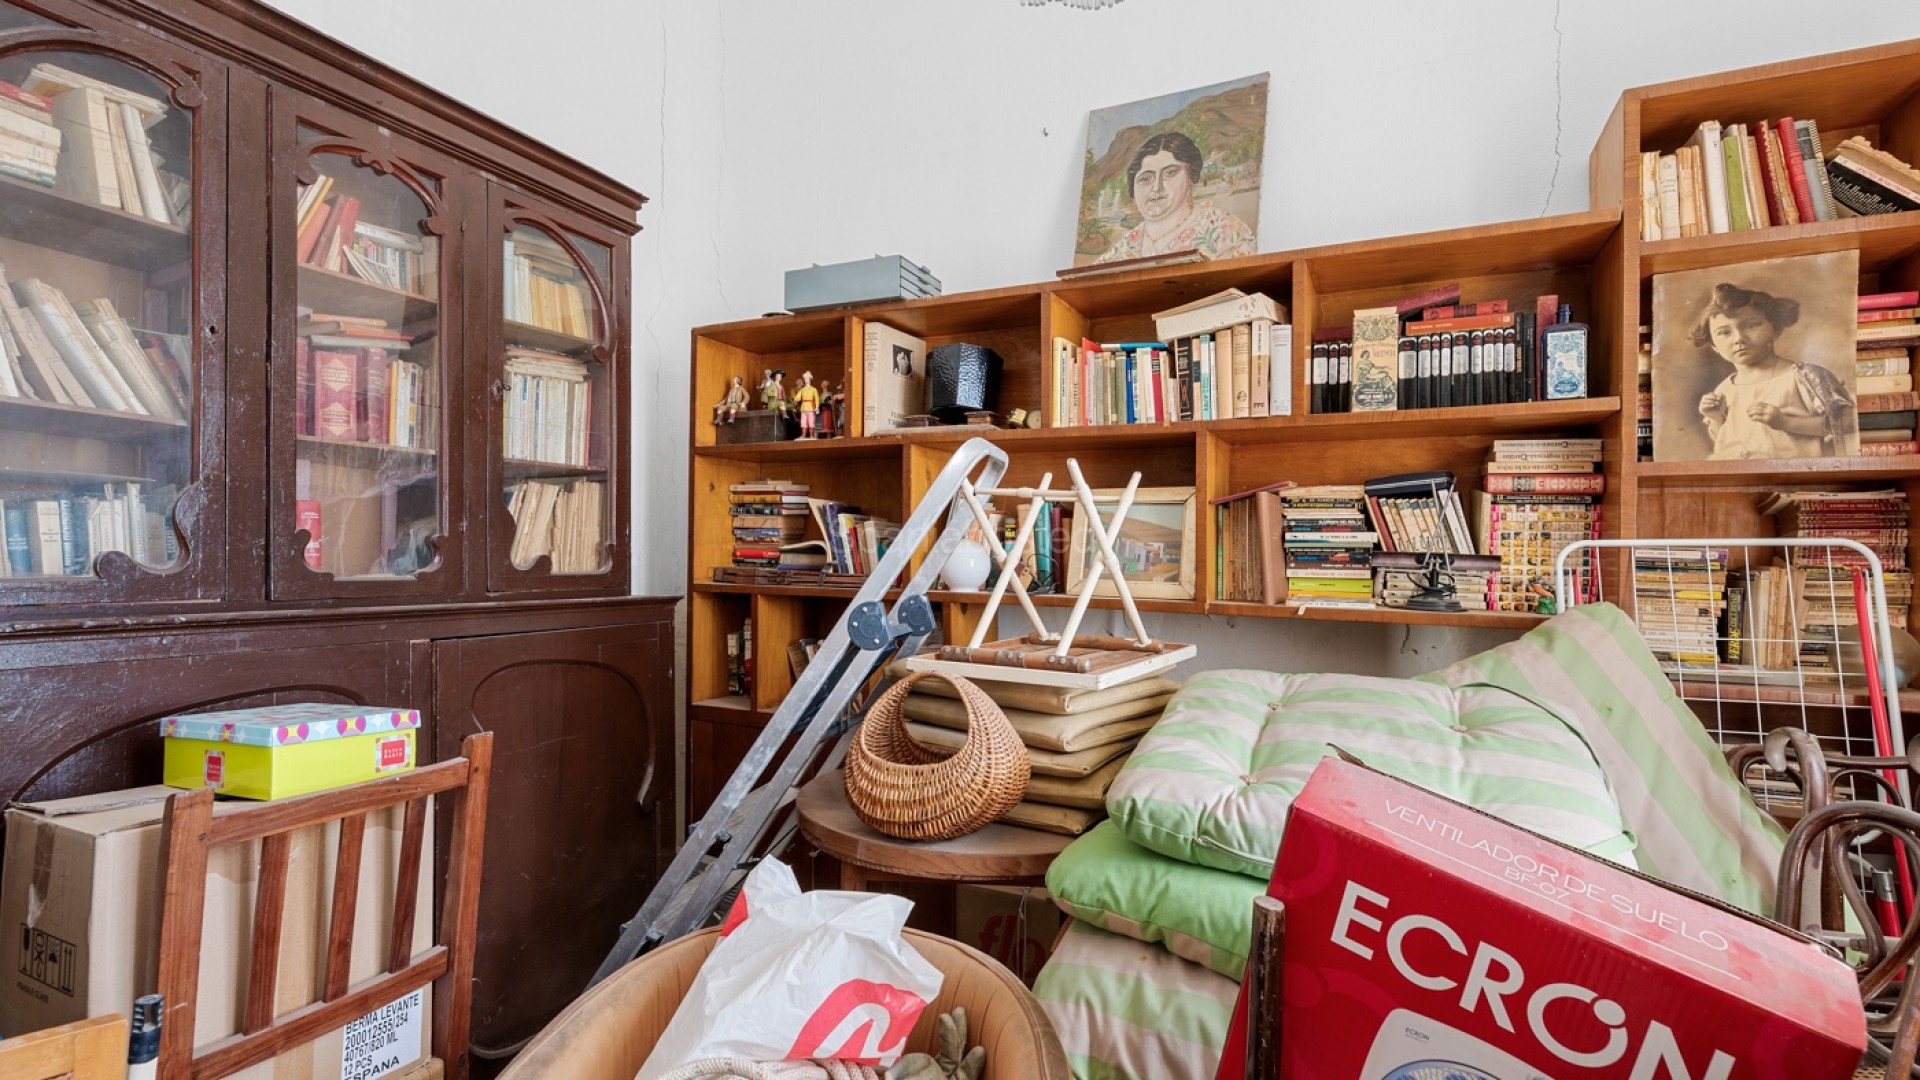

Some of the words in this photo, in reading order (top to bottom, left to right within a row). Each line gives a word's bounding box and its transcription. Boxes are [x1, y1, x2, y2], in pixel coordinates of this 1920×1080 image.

[1384, 799, 1559, 879] VENTILADOR
[1562, 871, 1607, 904] DE
[1610, 893, 1730, 953] SUELO
[1503, 866, 1571, 900] BF-07
[1330, 879, 1736, 1080] ECRON
[346, 1013, 378, 1035] BERMA
[381, 993, 419, 1021] LEVANTE
[1405, 1026, 1430, 1041] ECRON
[344, 1063, 354, 1077] 12
[355, 1054, 373, 1072] PCS
[344, 1056, 400, 1080] SPANA
